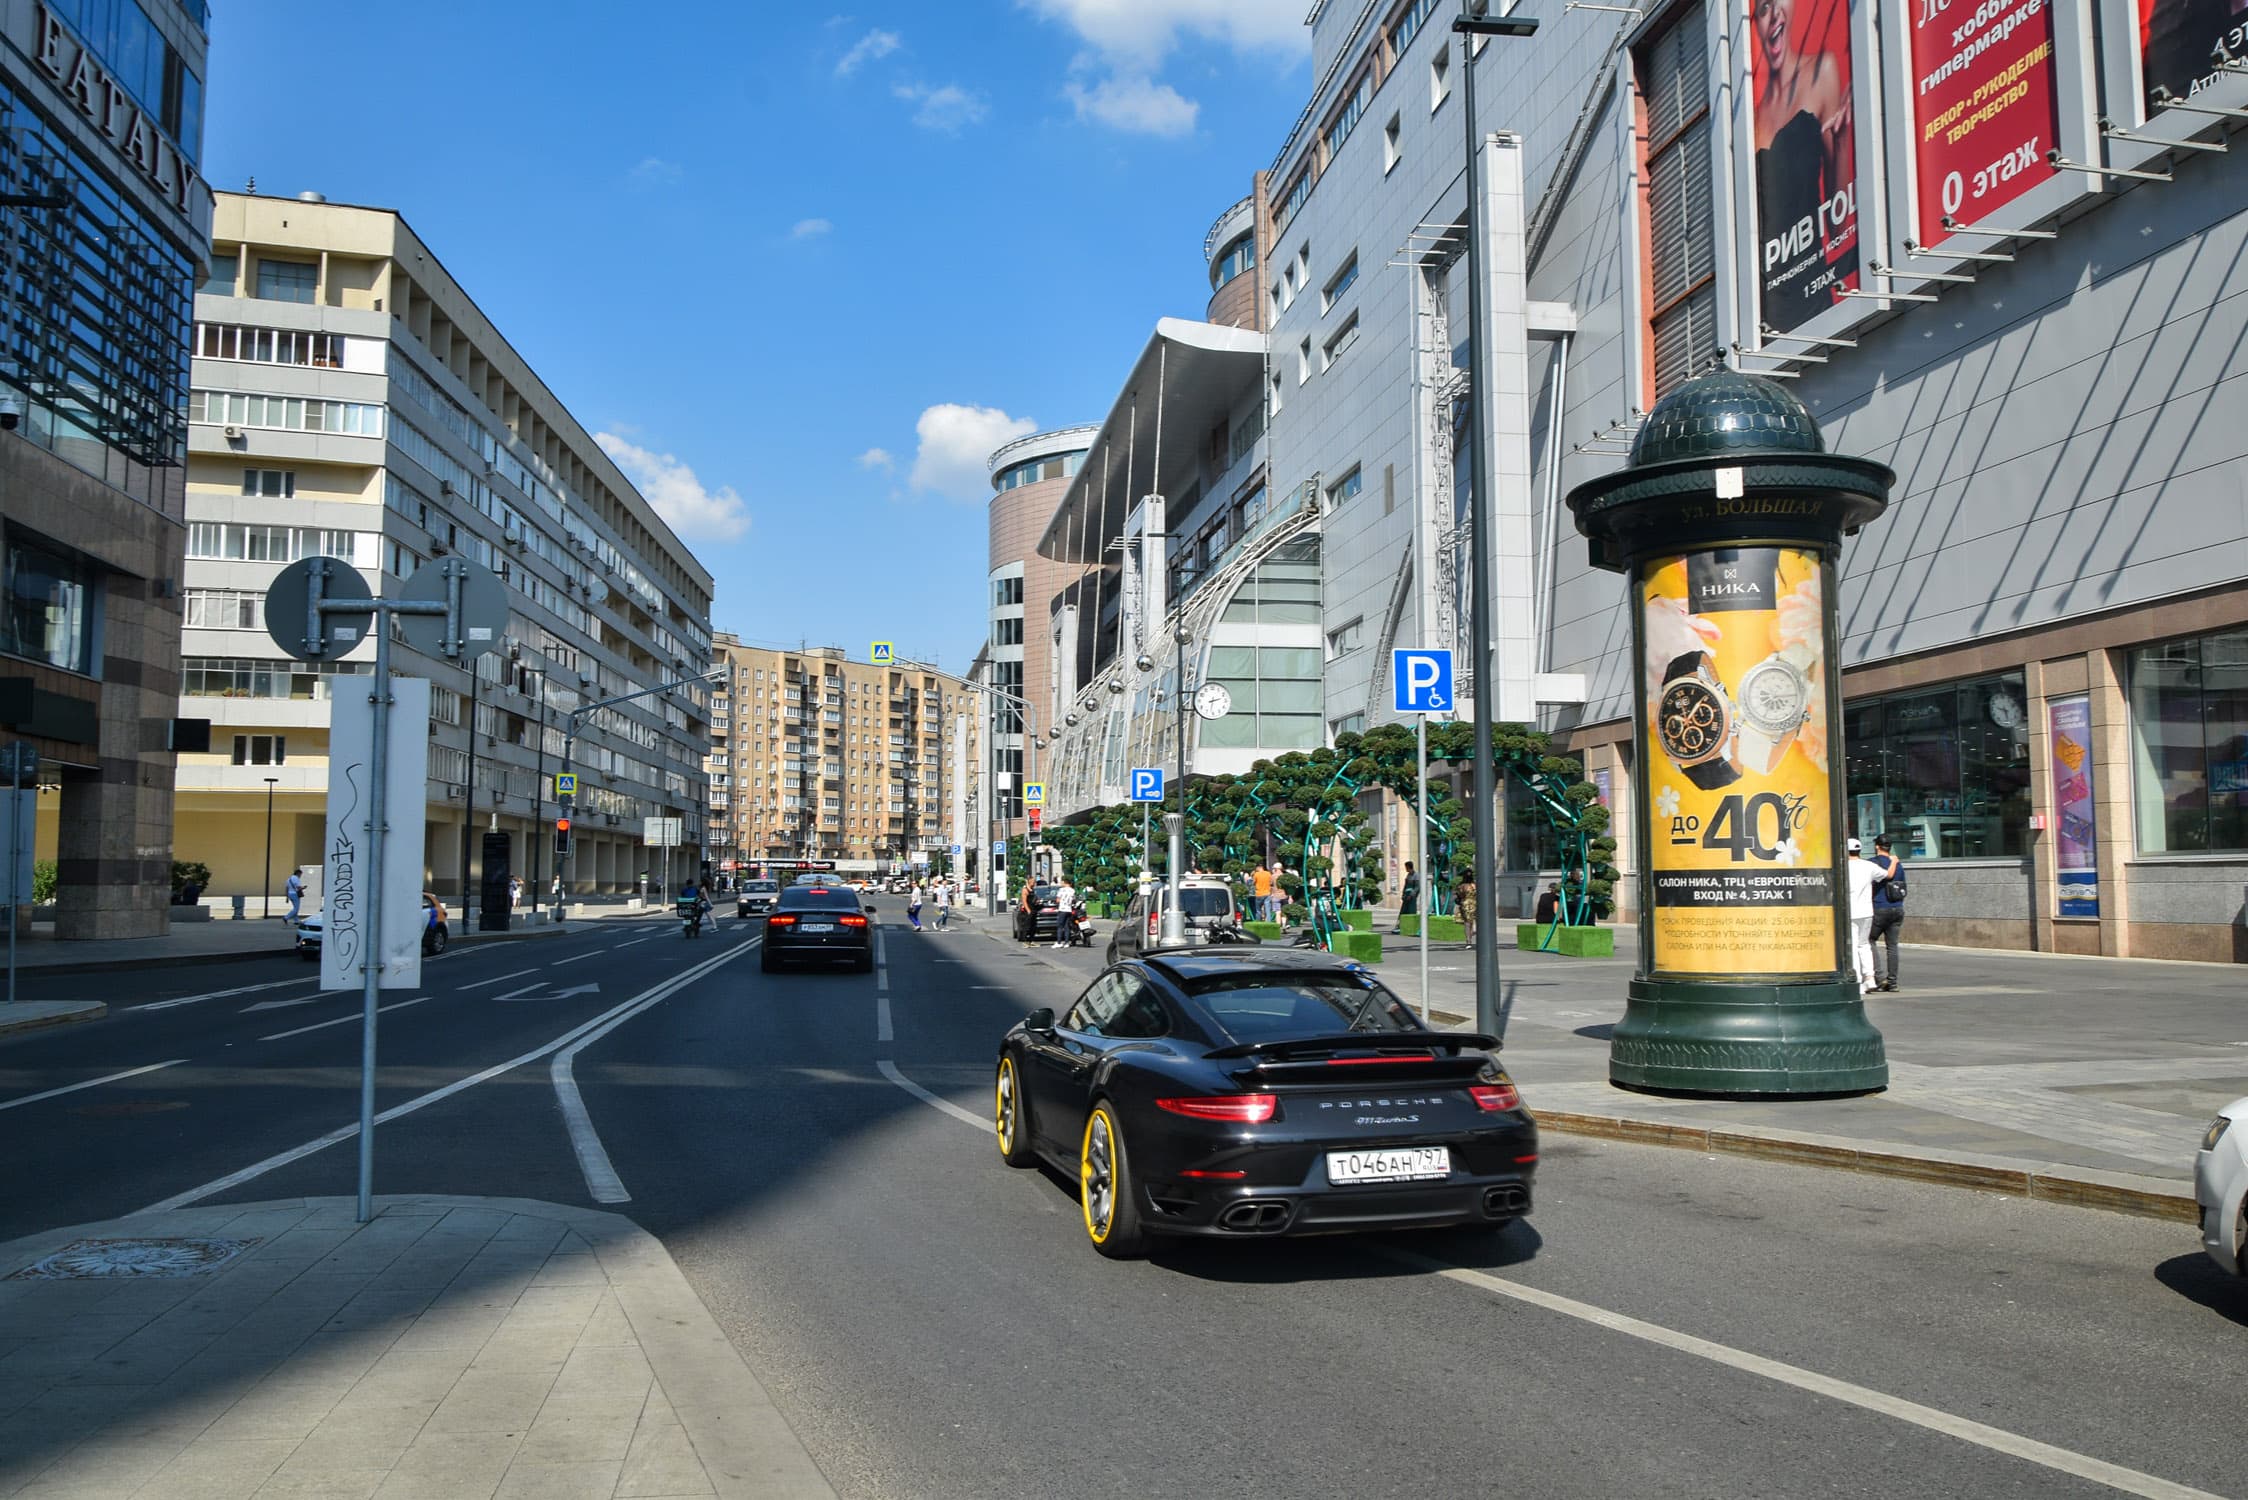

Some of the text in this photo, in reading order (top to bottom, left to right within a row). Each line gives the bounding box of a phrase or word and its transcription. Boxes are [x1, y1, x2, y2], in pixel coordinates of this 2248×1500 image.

[1920, 0, 2048, 96] гипермарке
[1925, 40, 2053, 142] ДЕКОР РУКОДЕЛИЕ
[36, 5, 198, 214] EATALY
[1946, 80, 2029, 145] ТВОРЧЕСТВО
[1942, 136, 2040, 215] 0 этаж
[1765, 215, 1815, 273] РИВ
[1803, 266, 1837, 298] 1 ЭТАЖ
[1716, 499, 1823, 517] БОЛЬШАЯ
[1702, 582, 1761, 597] НИКА
[1407, 656, 1441, 705] P
[1136, 771, 1155, 798] P
[1659, 877, 1688, 888] САЛОН
[1689, 877, 1722, 889] НИКА,
[1723, 876, 1746, 889] ТРЦ
[1693, 890, 1793, 902] ВХОД № 4, ЭТАЖ 1
[1319, 1098, 1444, 1110] PORSCHE
[1414, 1148, 1442, 1166] 797
